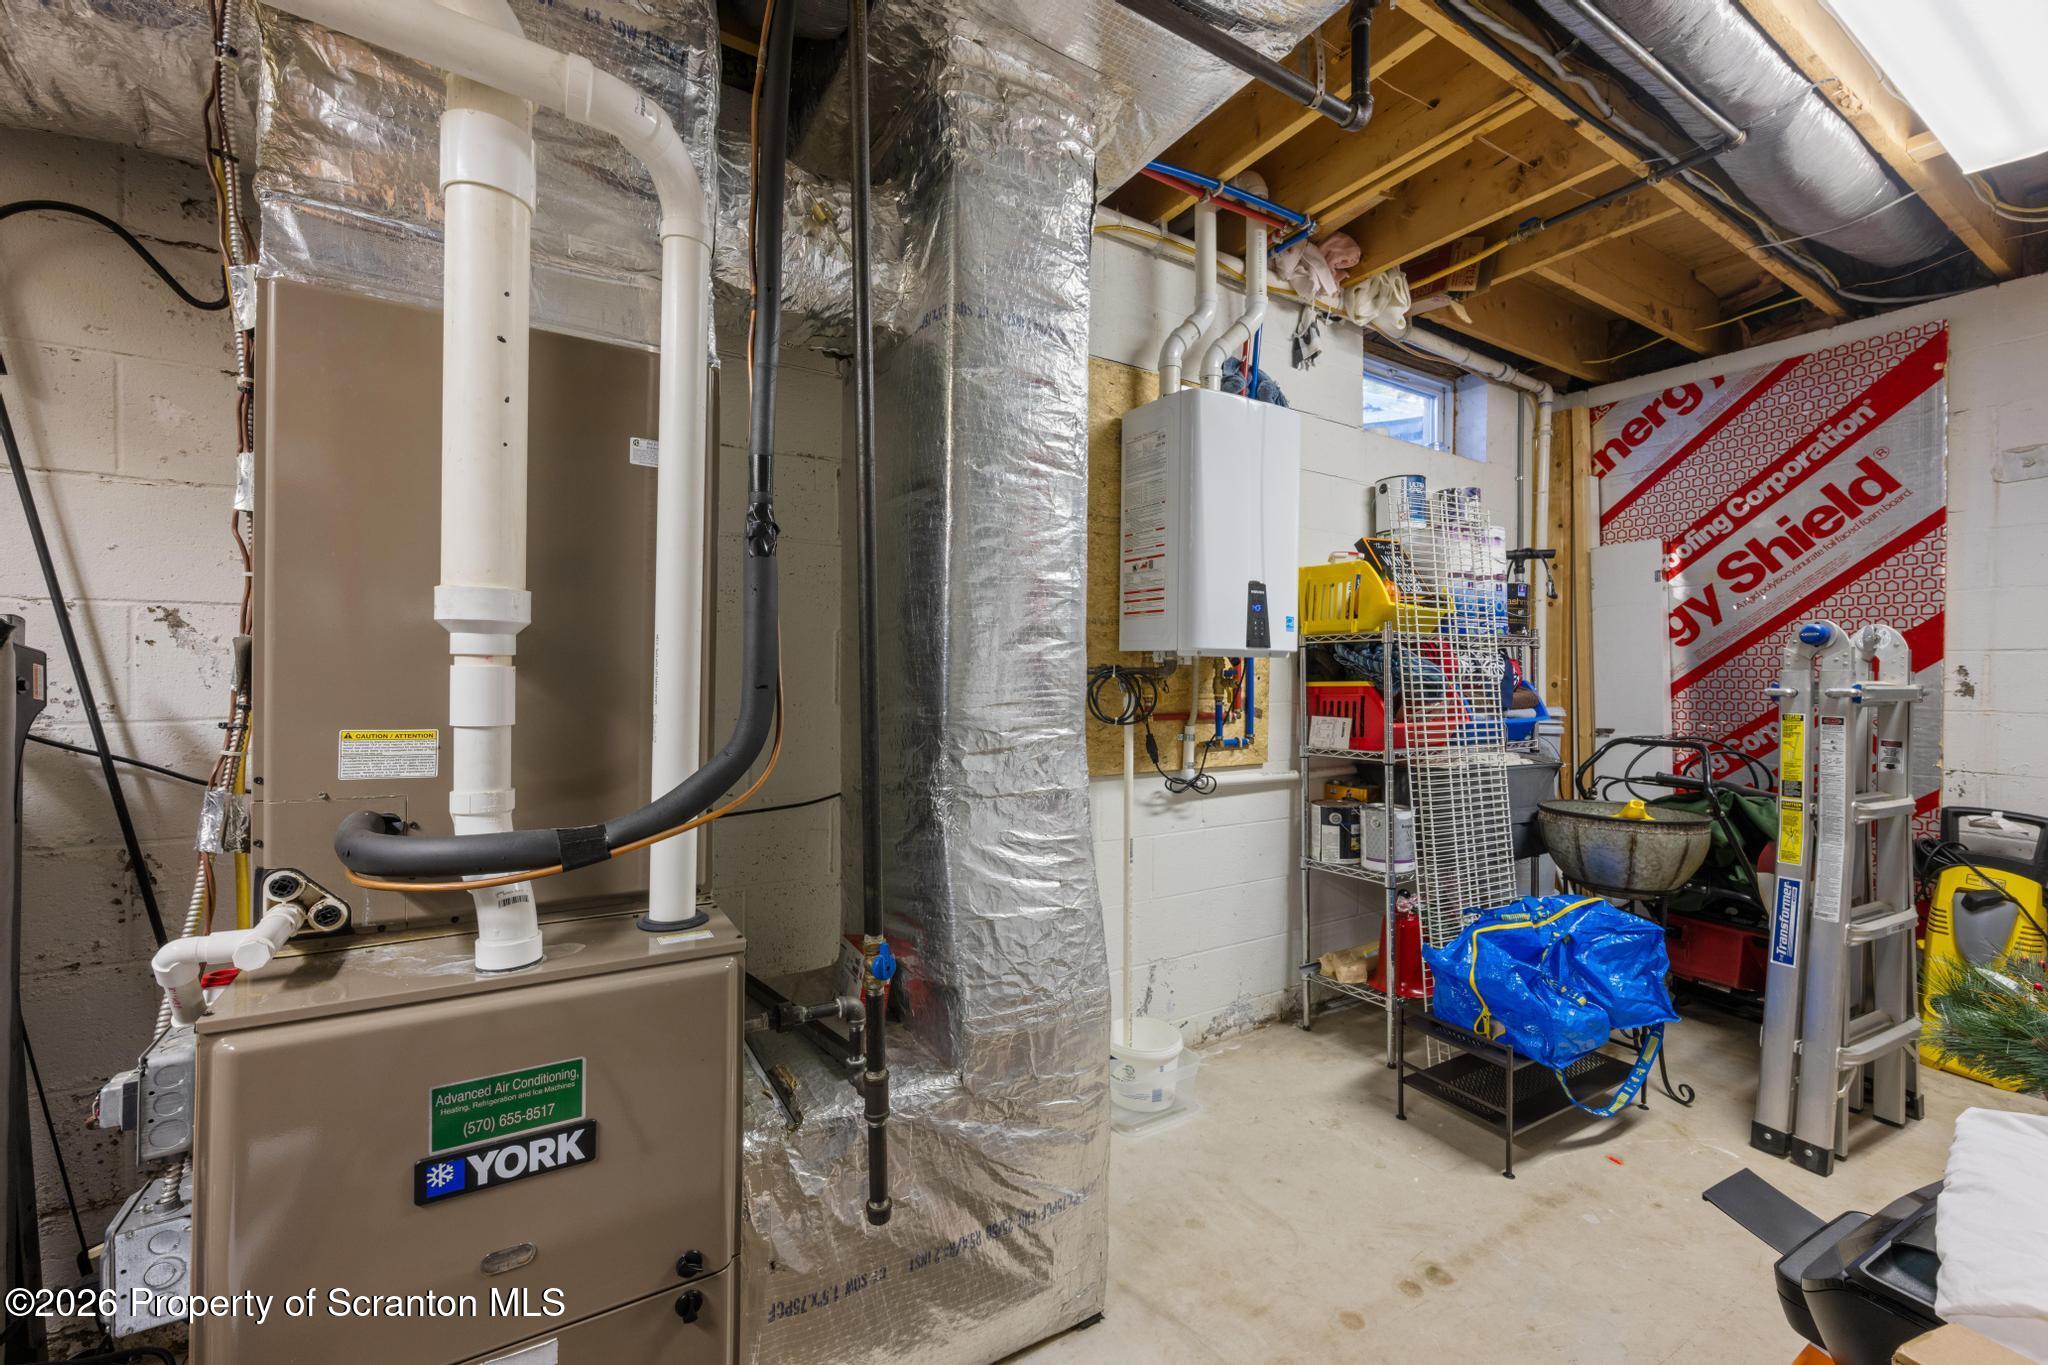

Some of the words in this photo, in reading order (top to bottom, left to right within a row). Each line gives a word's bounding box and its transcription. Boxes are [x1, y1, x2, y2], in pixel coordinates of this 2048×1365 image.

[1592, 374, 1725, 480] nerg
[1776, 882, 1793, 956] Transformer
[435, 1085, 491, 1107] Advanced
[495, 1080, 510, 1094] Air
[512, 1068, 580, 1091] Conditioning,
[440, 1105, 471, 1116] Heating,
[472, 1094, 516, 1109] Refrigeration
[518, 1090, 531, 1100] and
[532, 1087, 543, 1096] Ice
[544, 1081, 575, 1093] Machines
[463, 1116, 495, 1138] (570)
[499, 1103, 556, 1127] 655-8517
[467, 1128, 586, 1186] YORK
